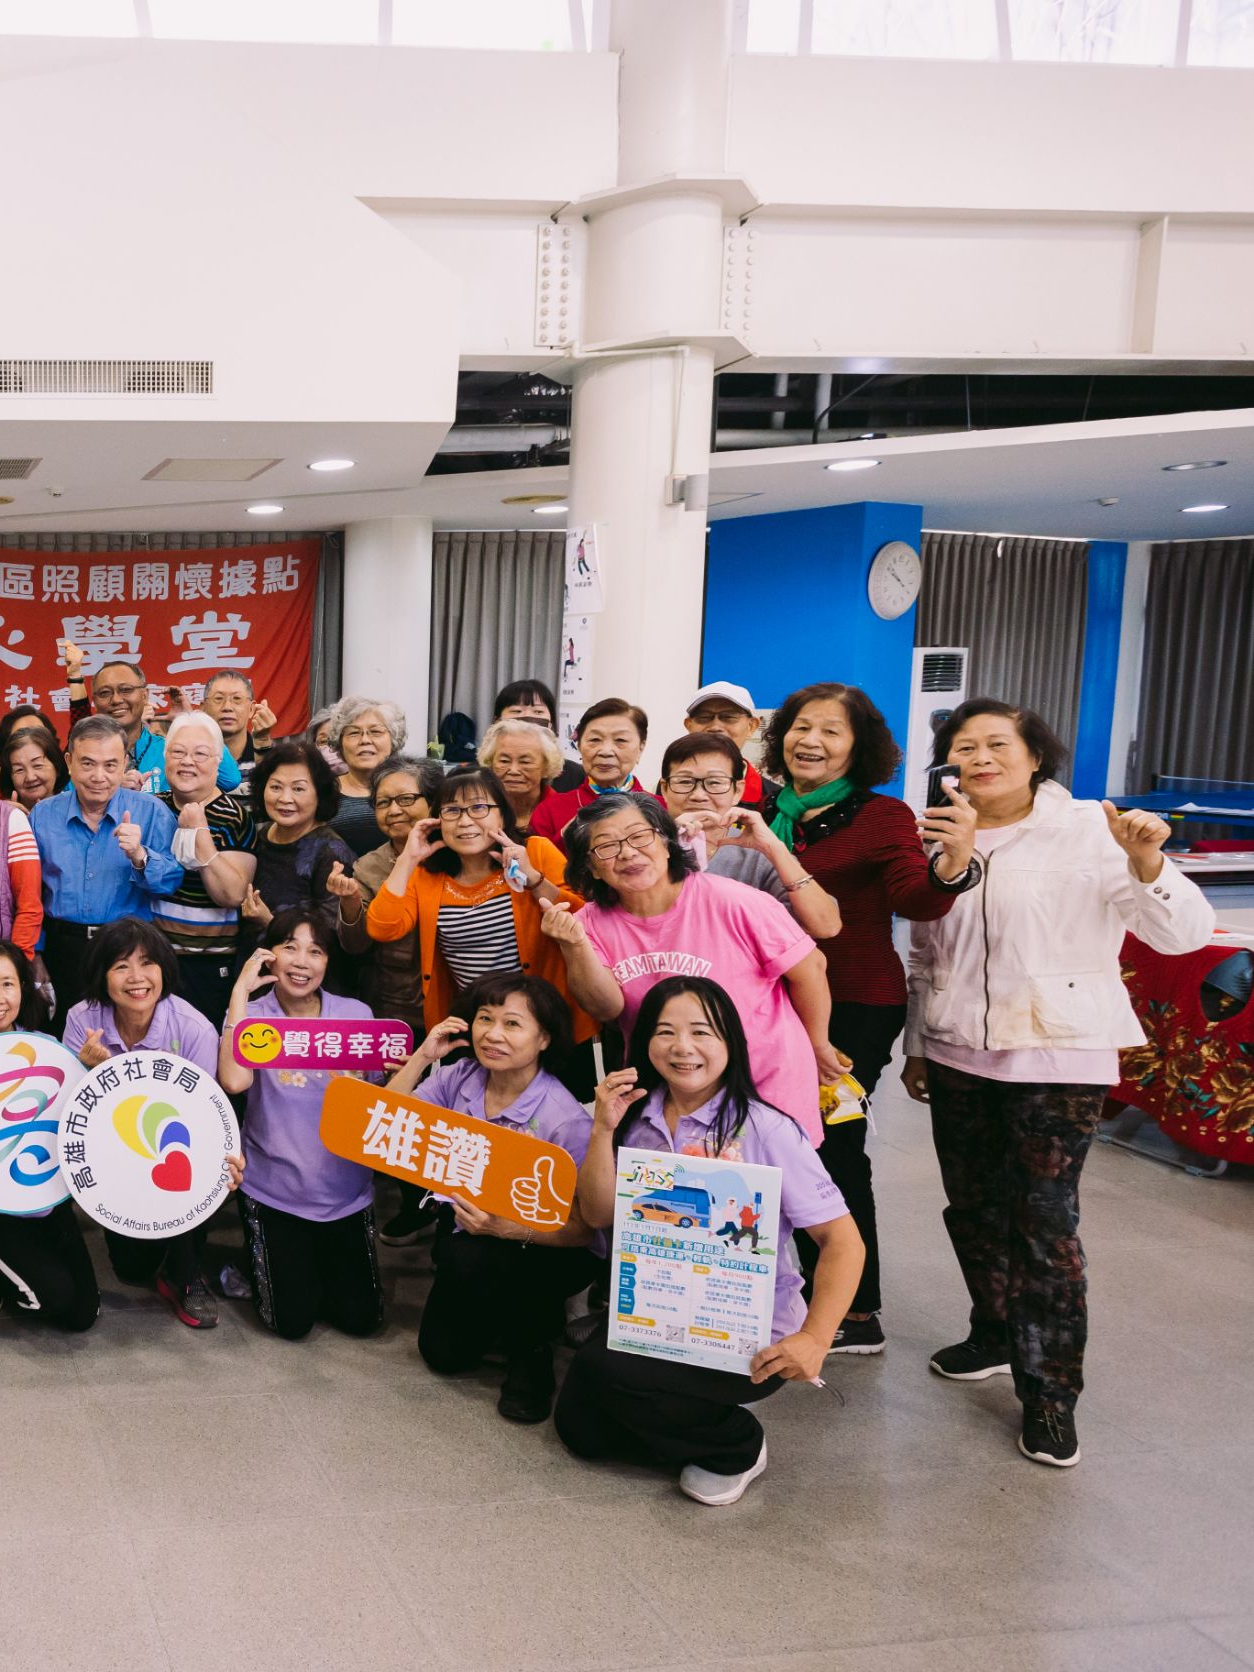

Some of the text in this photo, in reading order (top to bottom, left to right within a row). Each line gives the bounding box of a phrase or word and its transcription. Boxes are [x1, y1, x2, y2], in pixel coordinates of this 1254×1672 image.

[282, 1031, 409, 1060] 覺得幸福
[63, 1057, 201, 1194] 高雄市政府社會局
[209, 1093, 234, 1151] Government
[361, 1099, 492, 1198] 雄讚
[195, 1171, 230, 1215] Kaohsiung
[95, 1202, 123, 1225] Social
[122, 1217, 151, 1232] Affairs
[153, 1216, 185, 1232] Bureau
[186, 1209, 196, 1223] of
